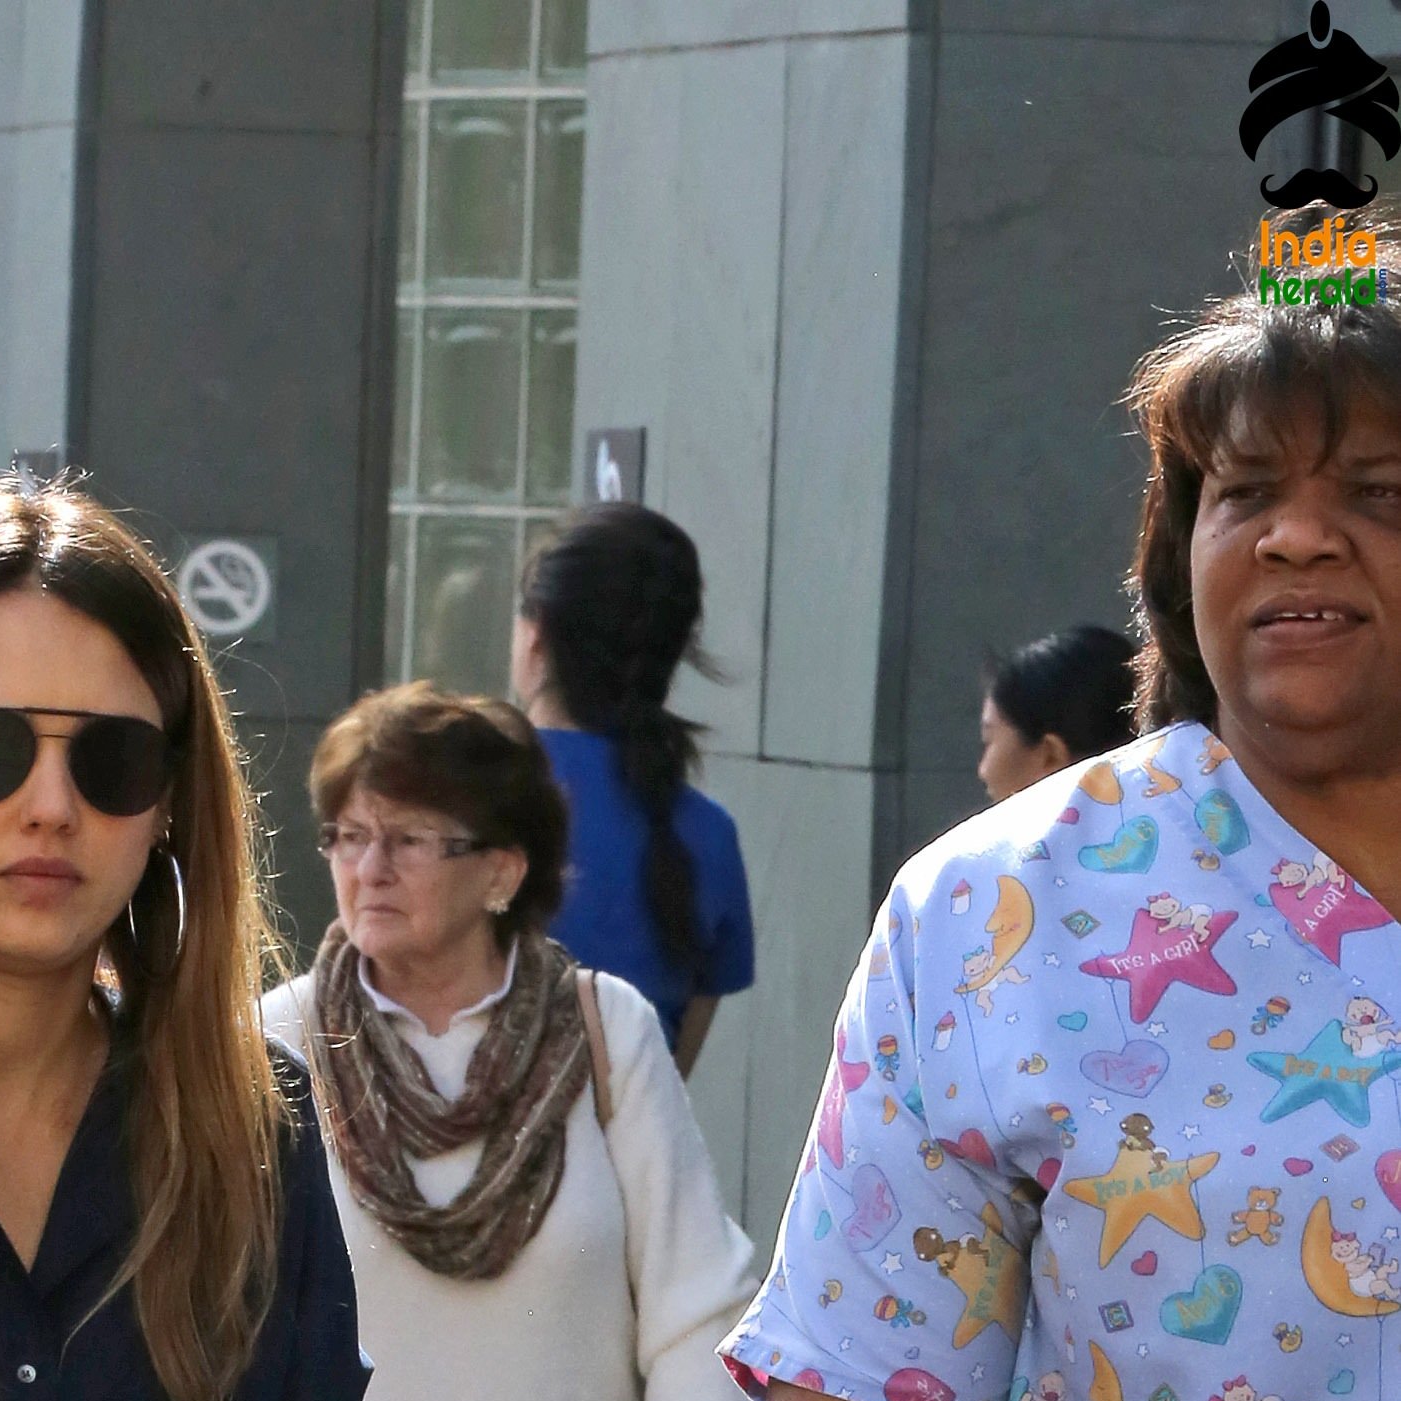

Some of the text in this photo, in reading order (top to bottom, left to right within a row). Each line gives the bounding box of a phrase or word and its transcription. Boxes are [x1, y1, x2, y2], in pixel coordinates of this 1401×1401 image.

[1109, 933, 1200, 974] IT'S A GIRL
